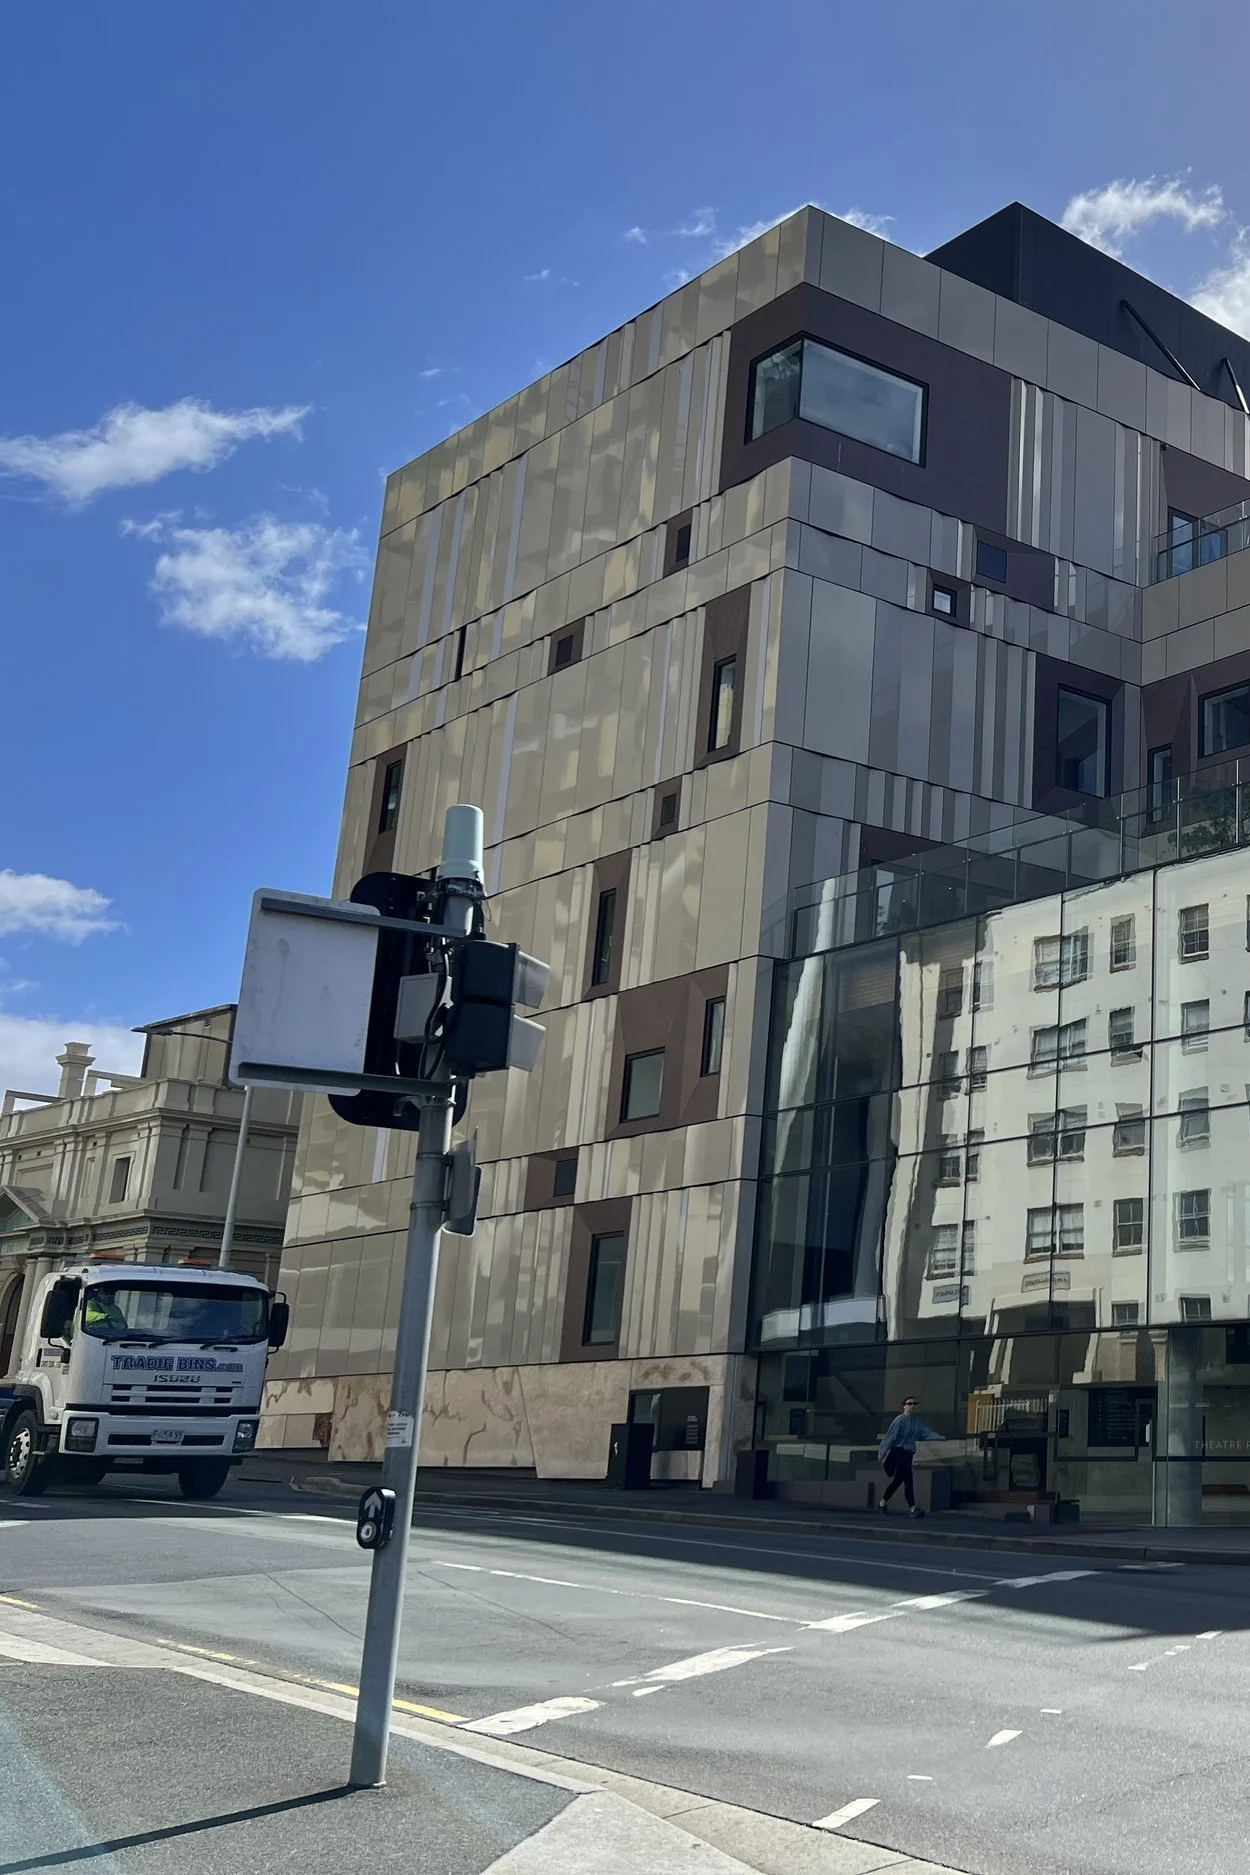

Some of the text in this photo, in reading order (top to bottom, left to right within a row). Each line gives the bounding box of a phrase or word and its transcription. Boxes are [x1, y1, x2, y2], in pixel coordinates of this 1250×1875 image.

[111, 1355, 174, 1371] TRADIE
[153, 1374, 201, 1383] ISUZU
[1194, 1440, 1242, 1450] THEATRE
